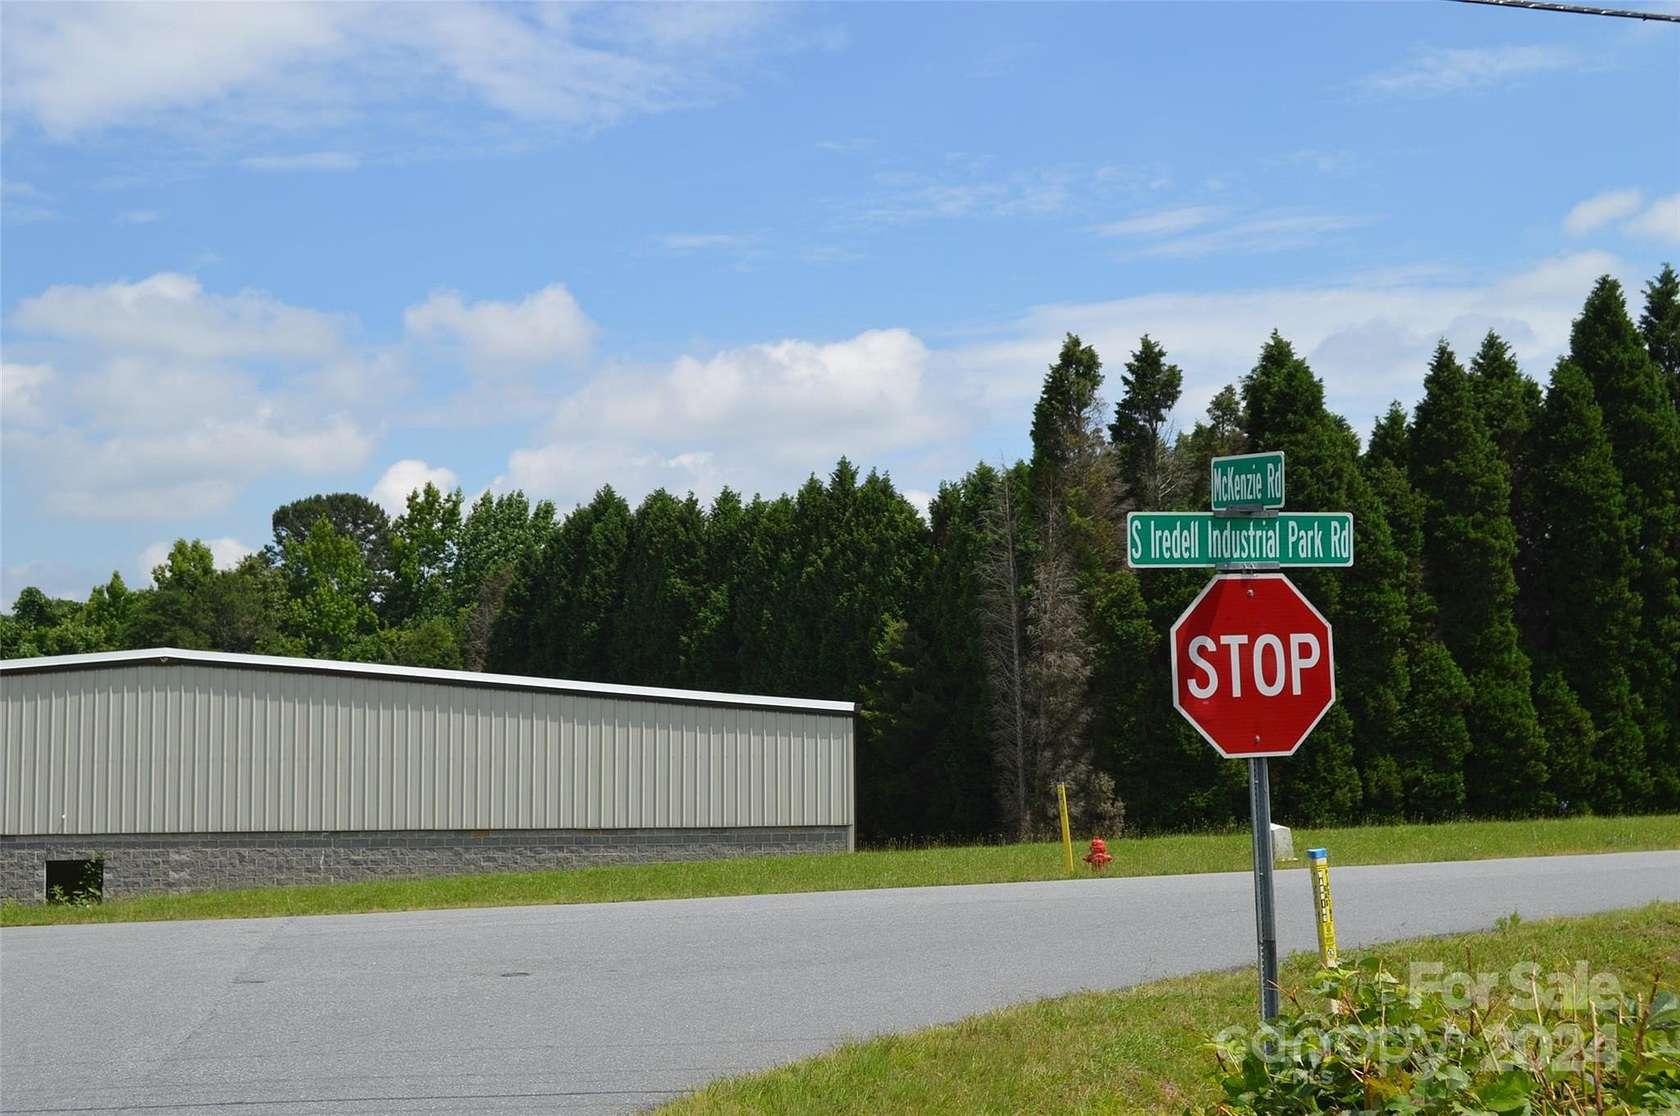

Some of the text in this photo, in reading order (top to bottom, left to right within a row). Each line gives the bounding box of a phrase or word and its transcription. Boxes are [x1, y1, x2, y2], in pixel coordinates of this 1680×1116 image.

[1213, 463, 1281, 501] McKenzie Rd
[1131, 520, 1349, 559] S Iredell Industrial Park Rd
[1187, 633, 1320, 699] STOP
